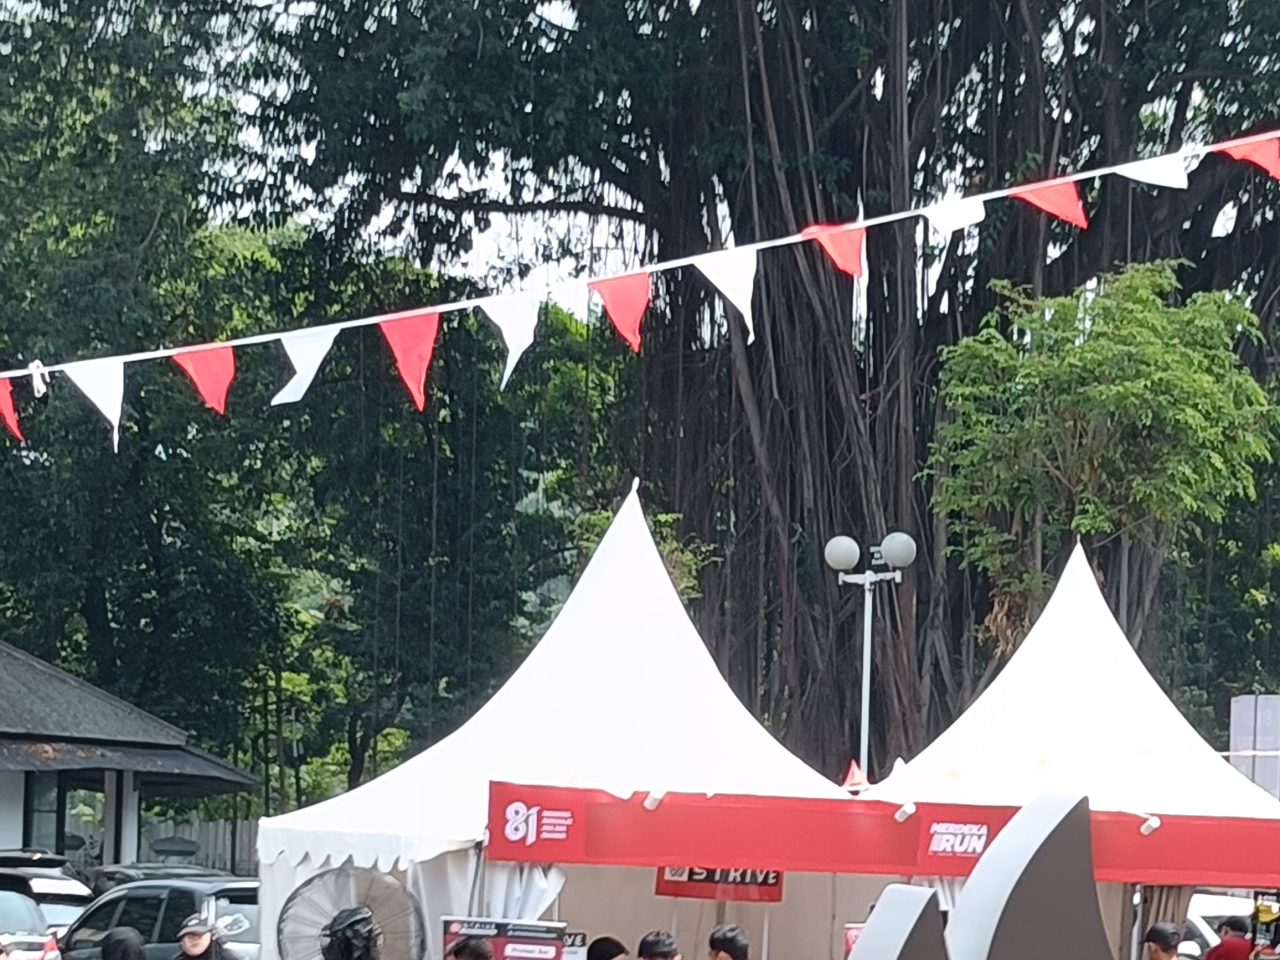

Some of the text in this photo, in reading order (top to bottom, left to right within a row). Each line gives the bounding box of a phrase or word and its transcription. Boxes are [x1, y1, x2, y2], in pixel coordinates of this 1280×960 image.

[504, 801, 541, 846] 81
[929, 822, 988, 835] MERDEKA
[940, 833, 984, 853] RUN
